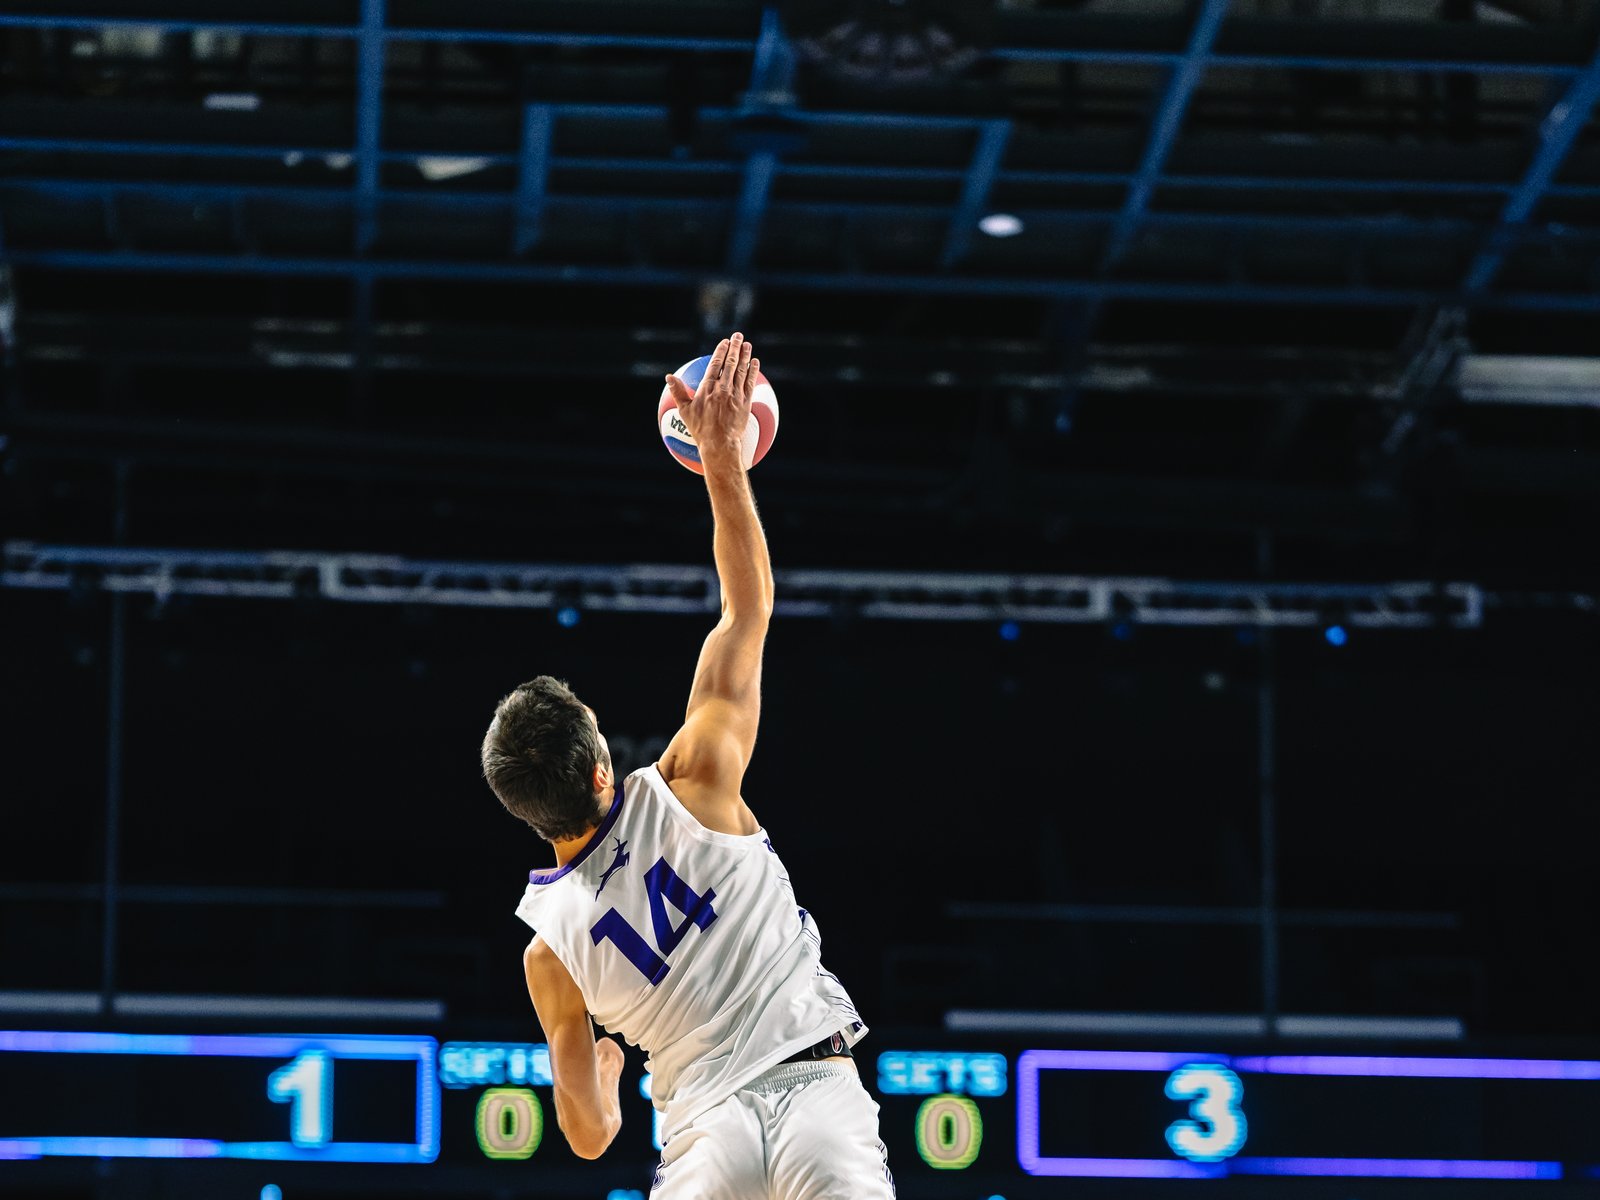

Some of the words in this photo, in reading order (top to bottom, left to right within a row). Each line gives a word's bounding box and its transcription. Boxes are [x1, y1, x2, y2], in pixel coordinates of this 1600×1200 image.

[590, 856, 718, 986] 14
[268, 1049, 333, 1149] 1
[476, 1087, 543, 1160] 0
[915, 1095, 983, 1170] 0
[1165, 1062, 1247, 1163] 3
